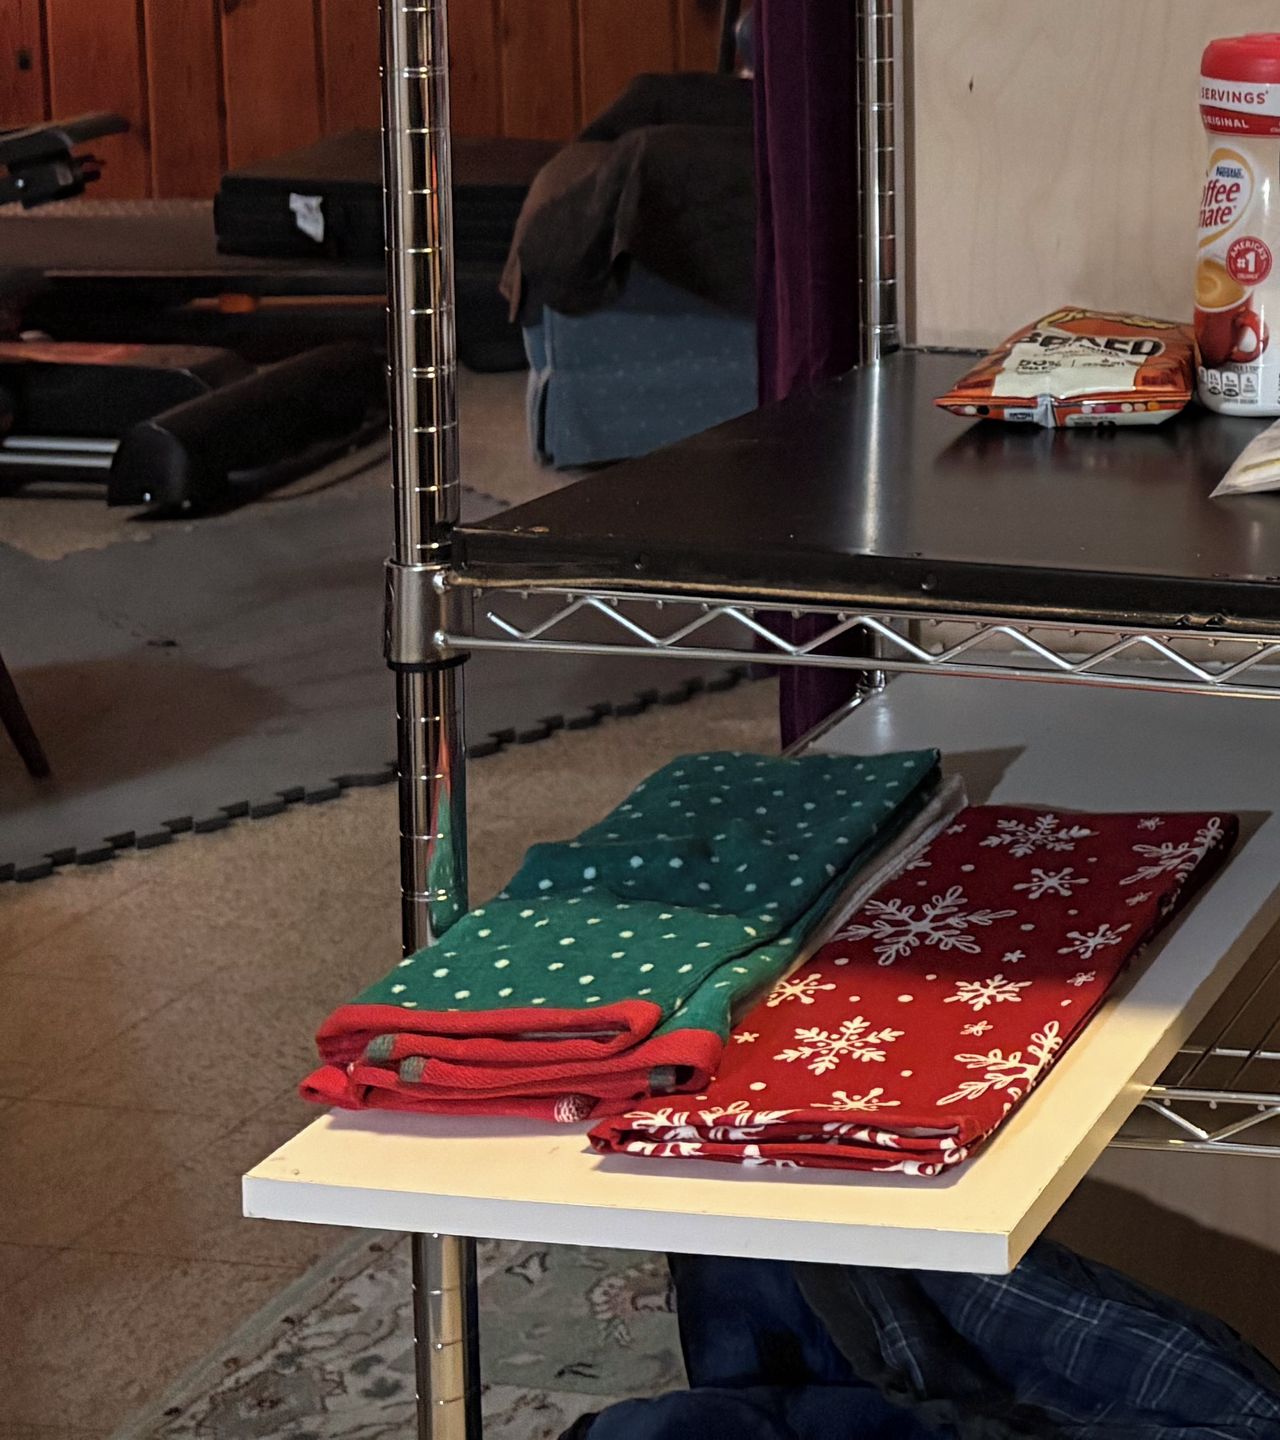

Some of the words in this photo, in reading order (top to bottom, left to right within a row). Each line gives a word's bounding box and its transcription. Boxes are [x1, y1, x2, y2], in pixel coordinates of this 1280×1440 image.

[1204, 180, 1241, 208] ffee
[1230, 240, 1268, 259] AMERICA'S
[1236, 251, 1256, 273] #1
